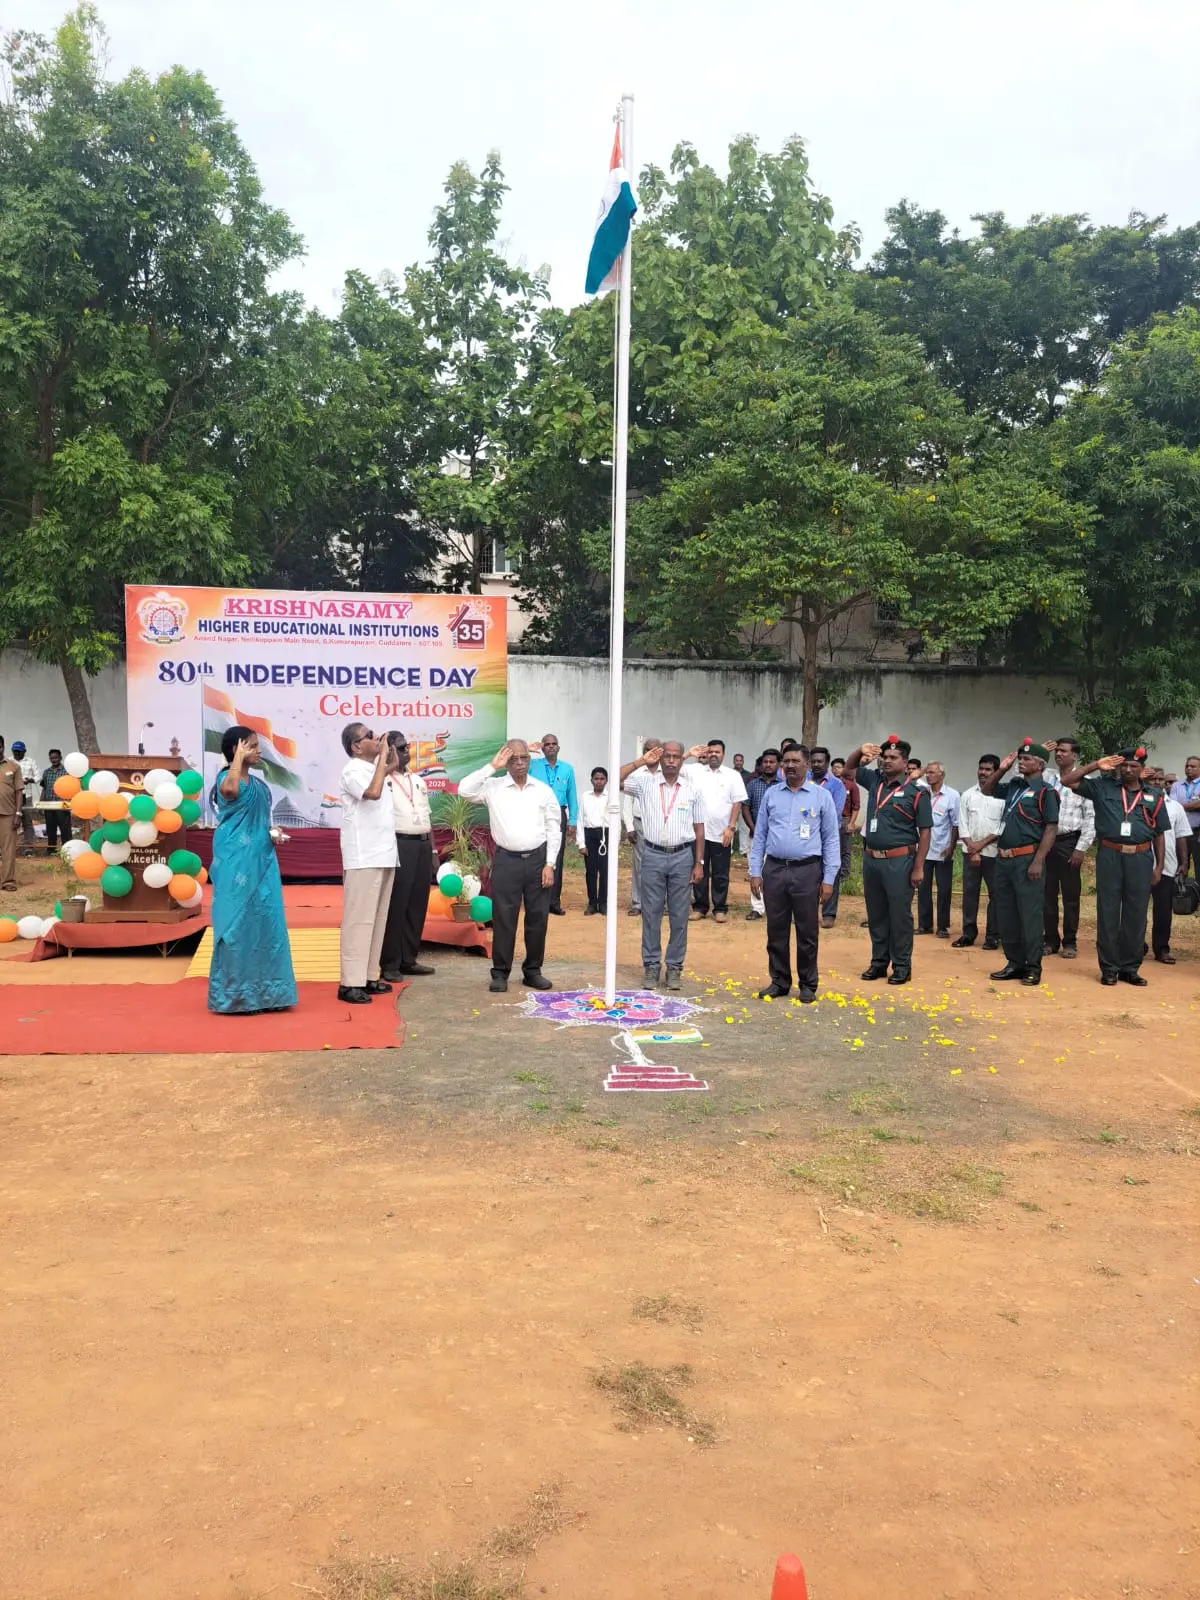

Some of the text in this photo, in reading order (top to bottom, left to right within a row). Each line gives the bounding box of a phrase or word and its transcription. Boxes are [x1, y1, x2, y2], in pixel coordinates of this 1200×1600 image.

[226, 598, 411, 619] KRISHNASAMY
[198, 619, 440, 638] HIGHER EDUCATIONAL INSTITUTIONS
[459, 624, 483, 641] 35
[158, 660, 476, 688] 80th INDEPENDENCE DAY
[319, 695, 474, 718] Celebrations
